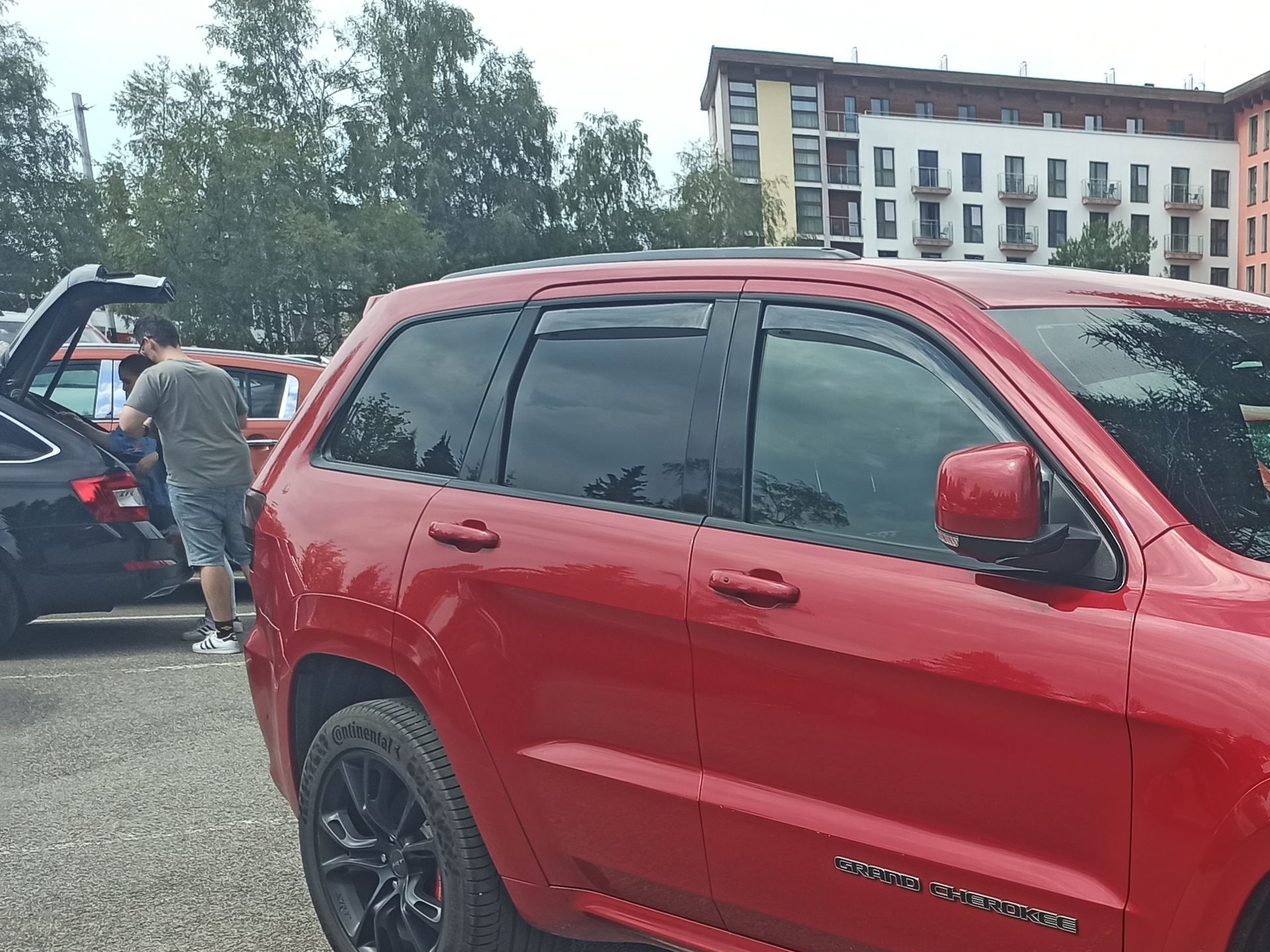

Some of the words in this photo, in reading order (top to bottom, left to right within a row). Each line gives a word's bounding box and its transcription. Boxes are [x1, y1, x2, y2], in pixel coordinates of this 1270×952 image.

[332, 721, 393, 755] Continental
[834, 856, 920, 892] GRAND
[929, 881, 1077, 933] CHEROKEE
